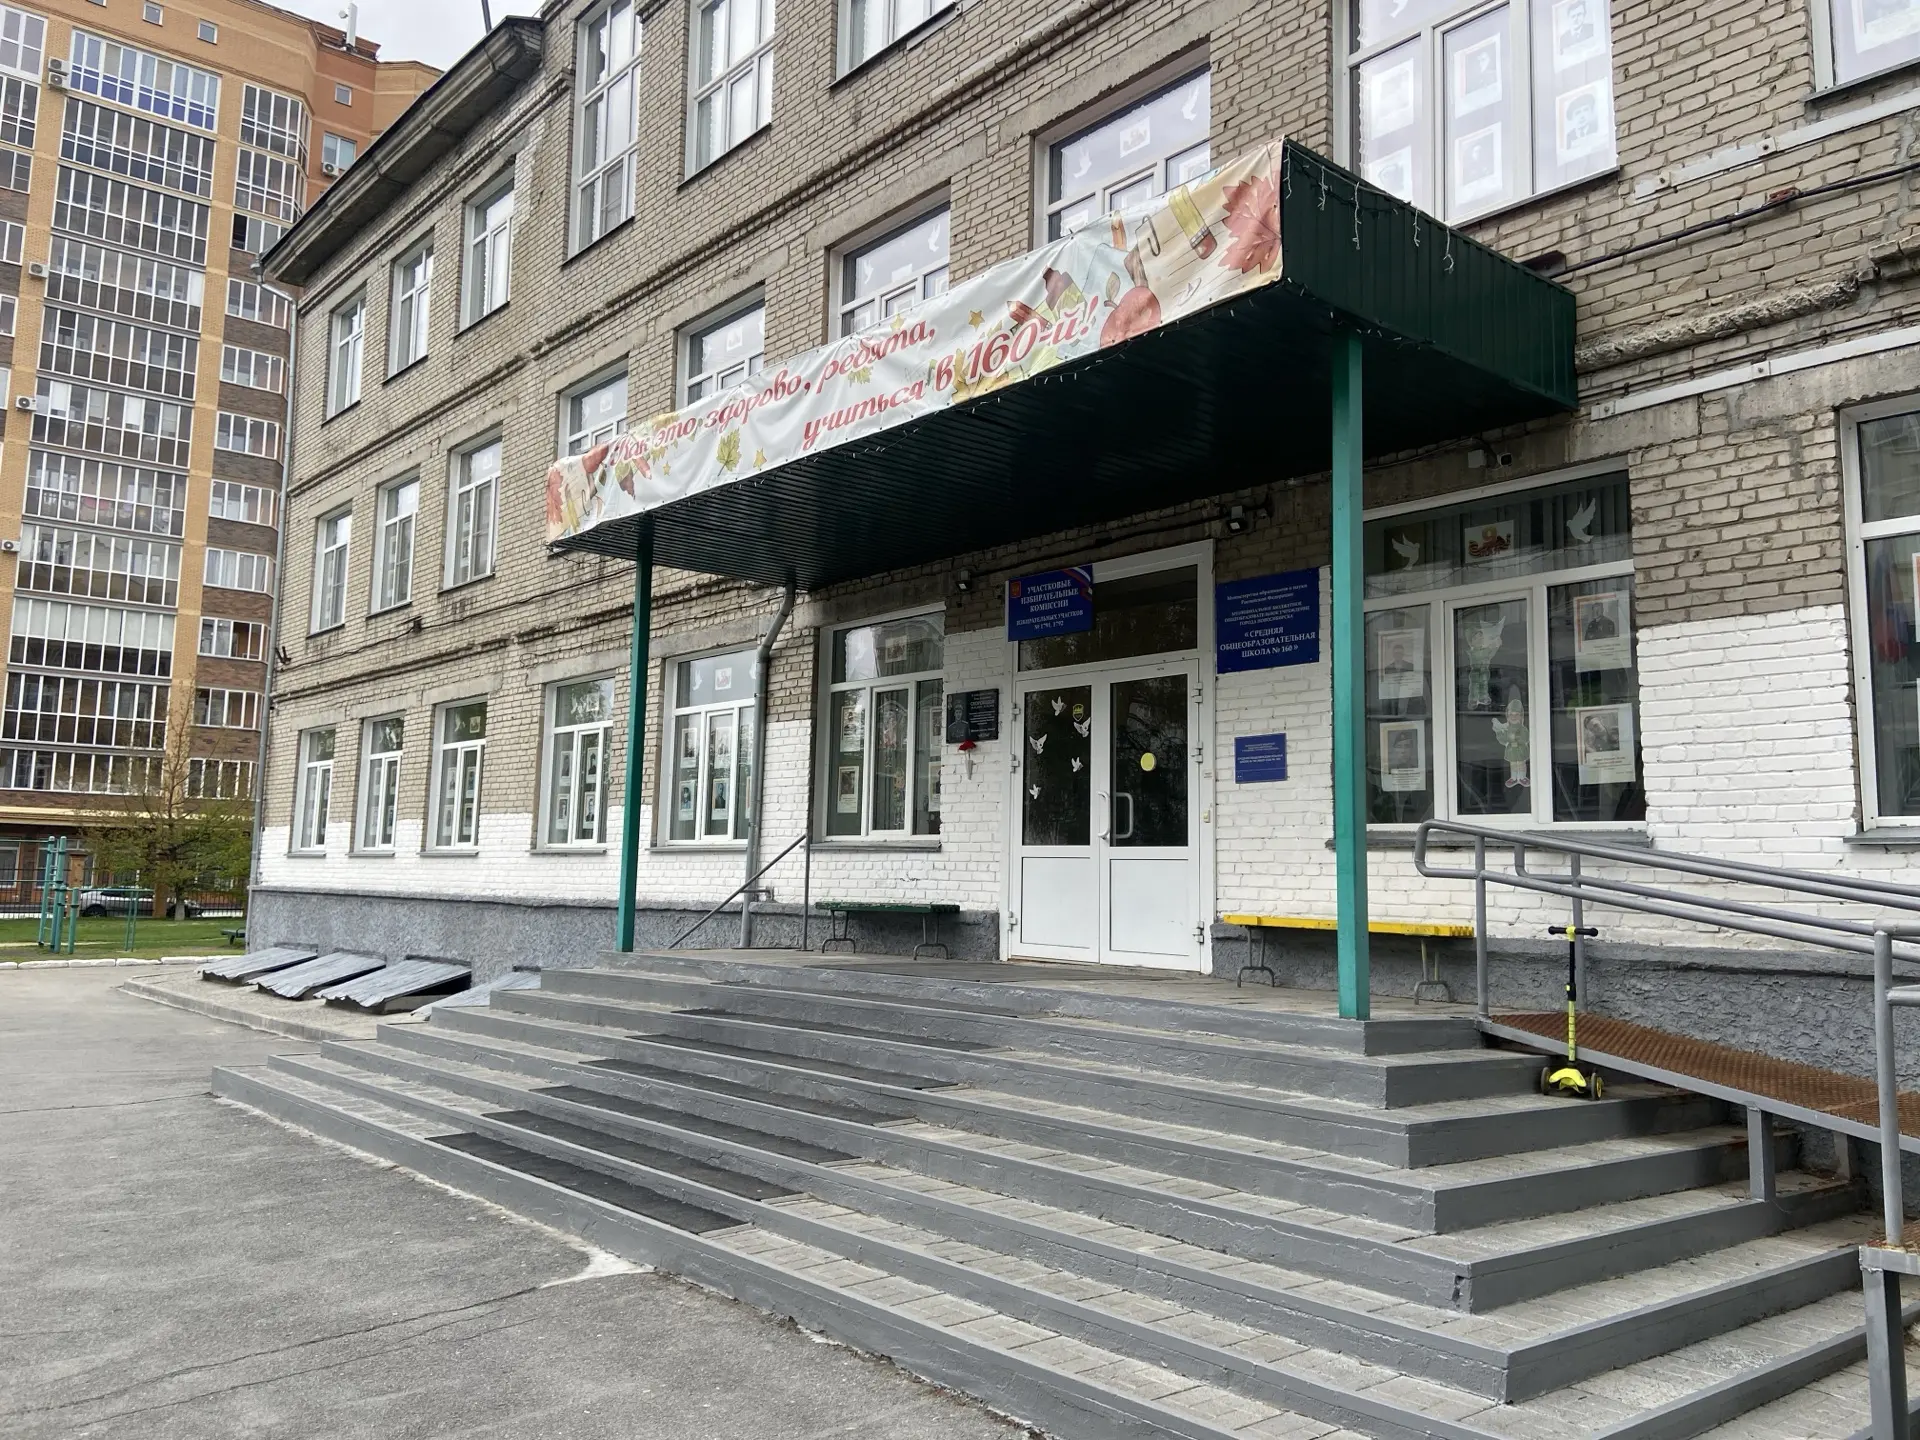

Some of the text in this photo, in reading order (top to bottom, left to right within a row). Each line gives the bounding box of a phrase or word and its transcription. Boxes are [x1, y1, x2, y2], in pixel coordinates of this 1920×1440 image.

[802, 295, 1099, 451] учиться в 160-й!
[609, 320, 936, 467] Как это здорово, ребята,
[1027, 580, 1072, 594] УЧАСТКОВЫЕ
[1021, 588, 1079, 604] ИЗБИРАТЕЛЬНЫЕ
[1030, 599, 1069, 612] КОМИССИИ
[1016, 609, 1084, 626] ИЗБИРАТЕЛЬНЫХ УЧАСТКОВ
[1219, 631, 1316, 651] ОБЩЕОБРАЗОВАТЕЛЬНАЯ
[1241, 648, 1271, 658] ШКОЛА
[1271, 646, 1280, 654] №
